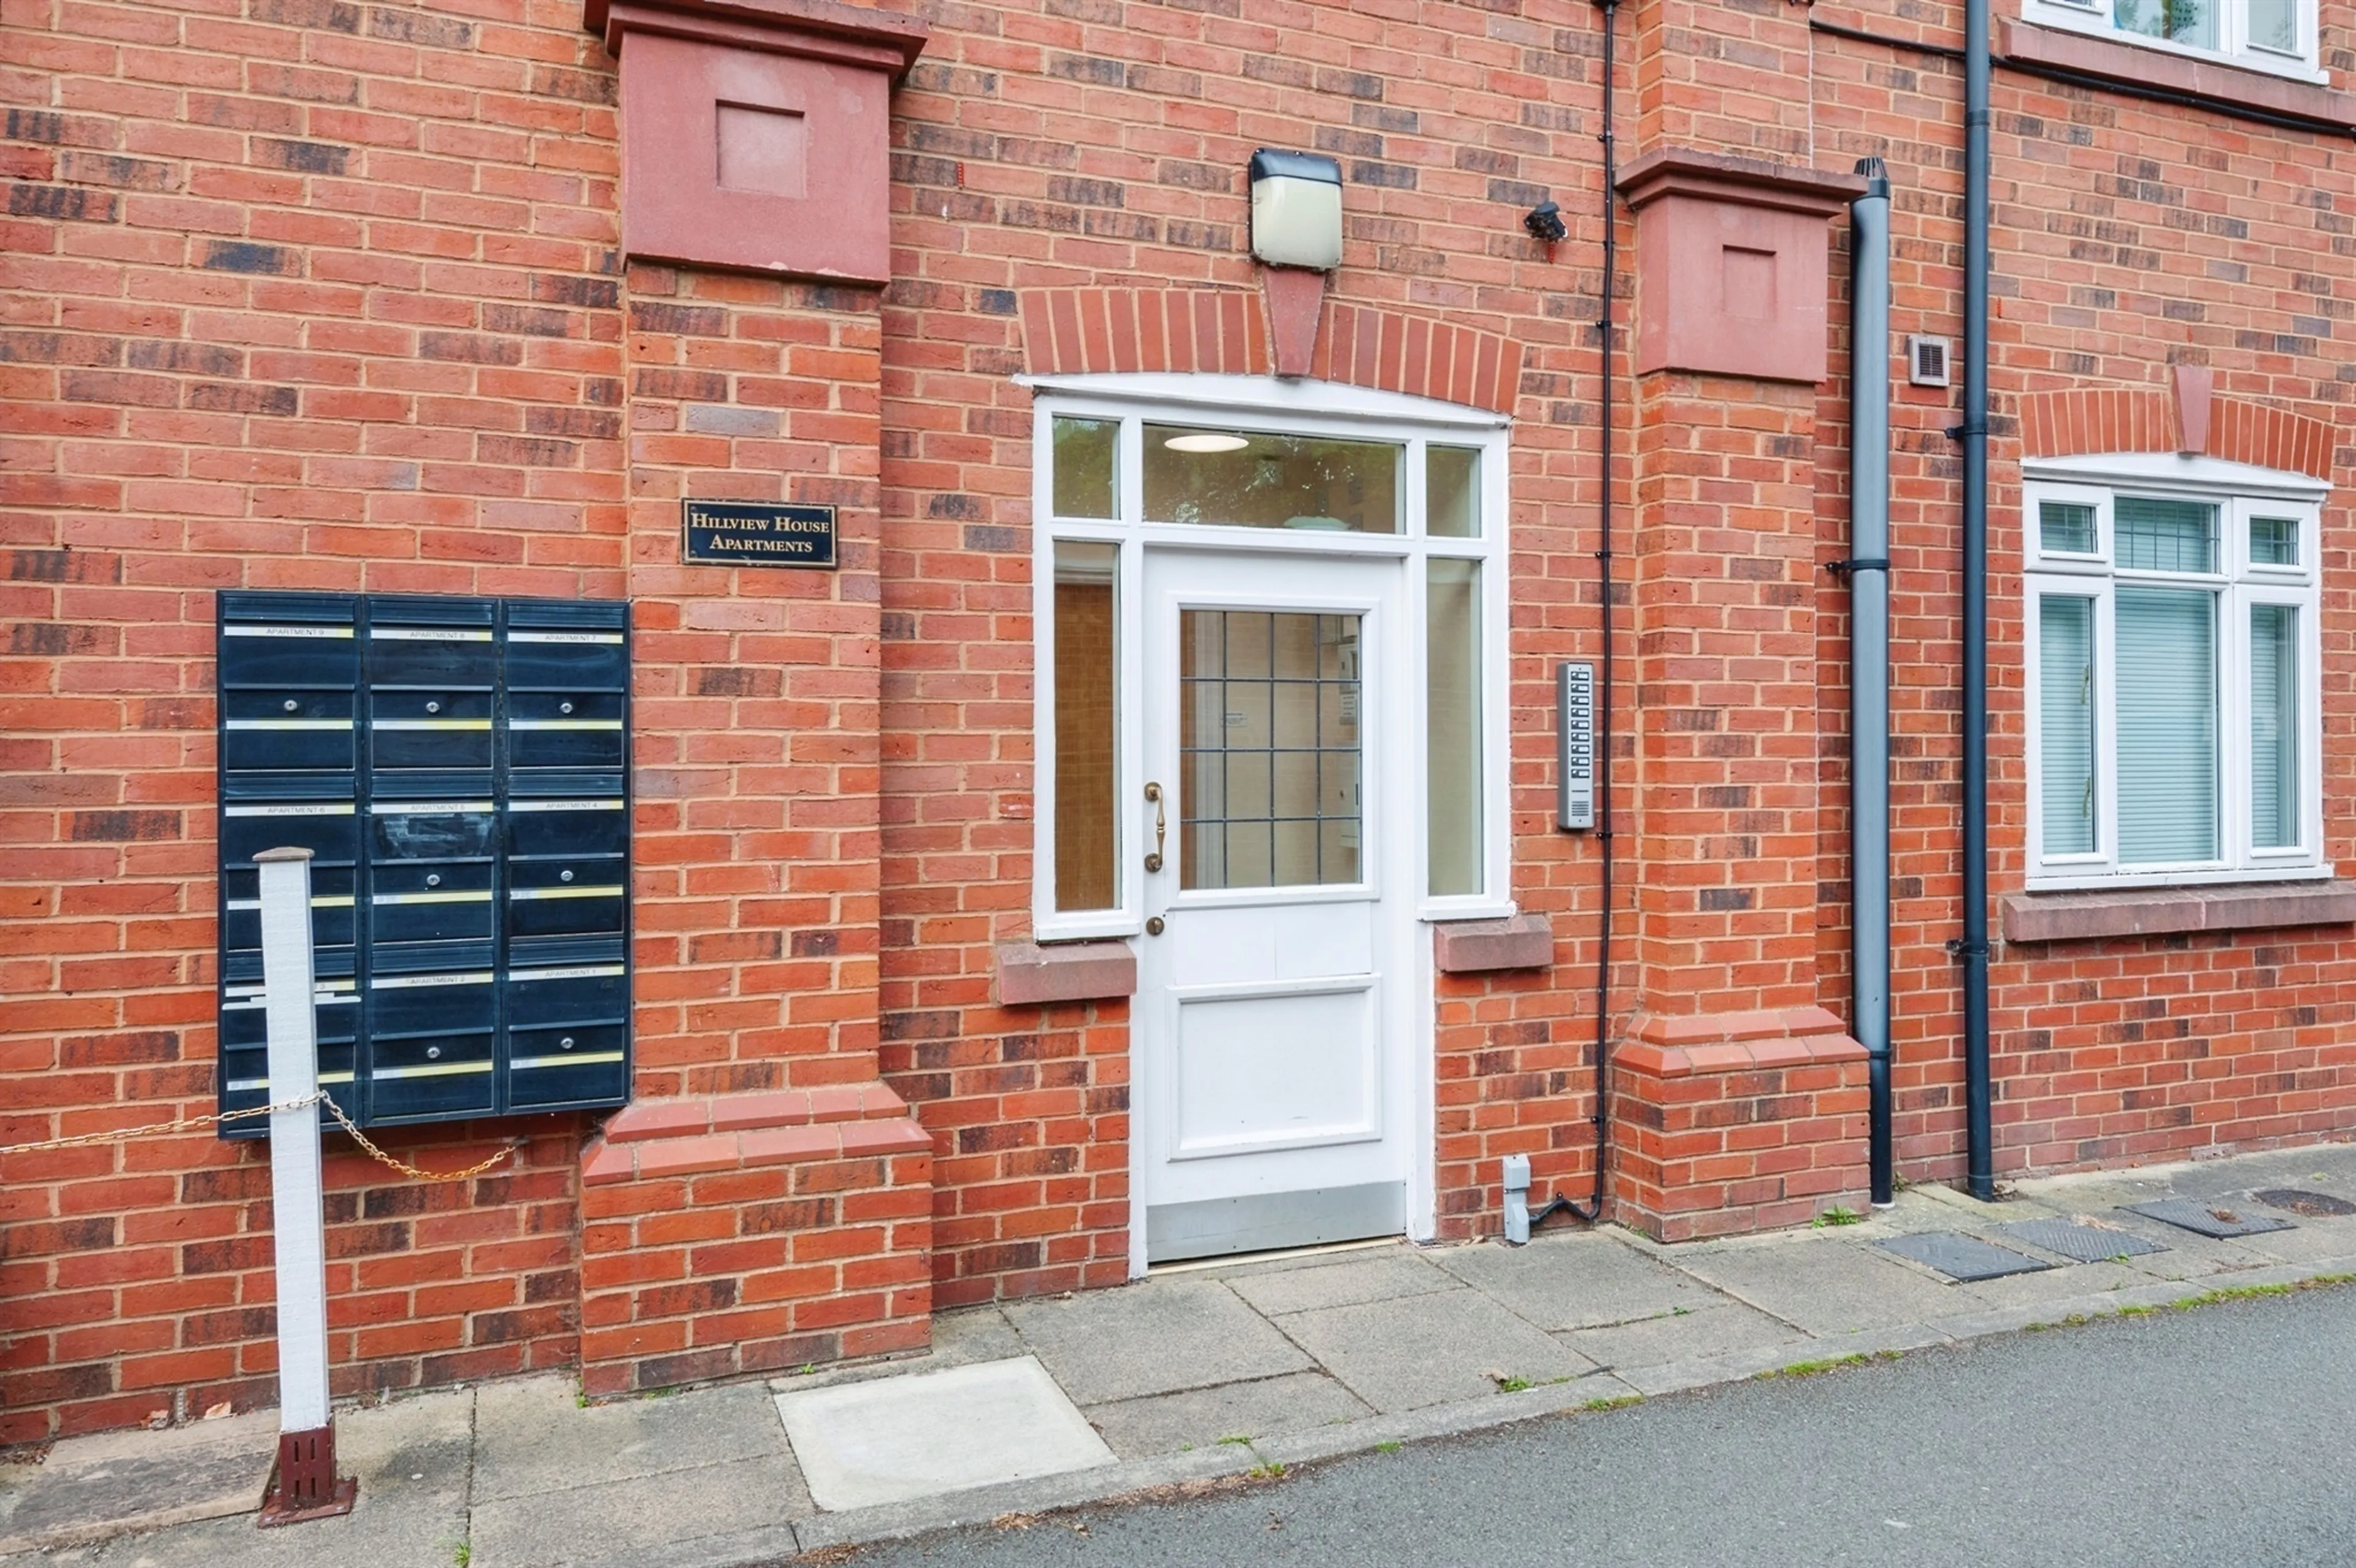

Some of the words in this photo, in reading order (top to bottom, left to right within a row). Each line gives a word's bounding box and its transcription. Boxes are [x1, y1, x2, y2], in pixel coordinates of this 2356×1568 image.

[691, 513, 769, 531] HILLVIEW
[774, 516, 830, 532] HOUSE
[709, 534, 813, 552] APARTMENTS
